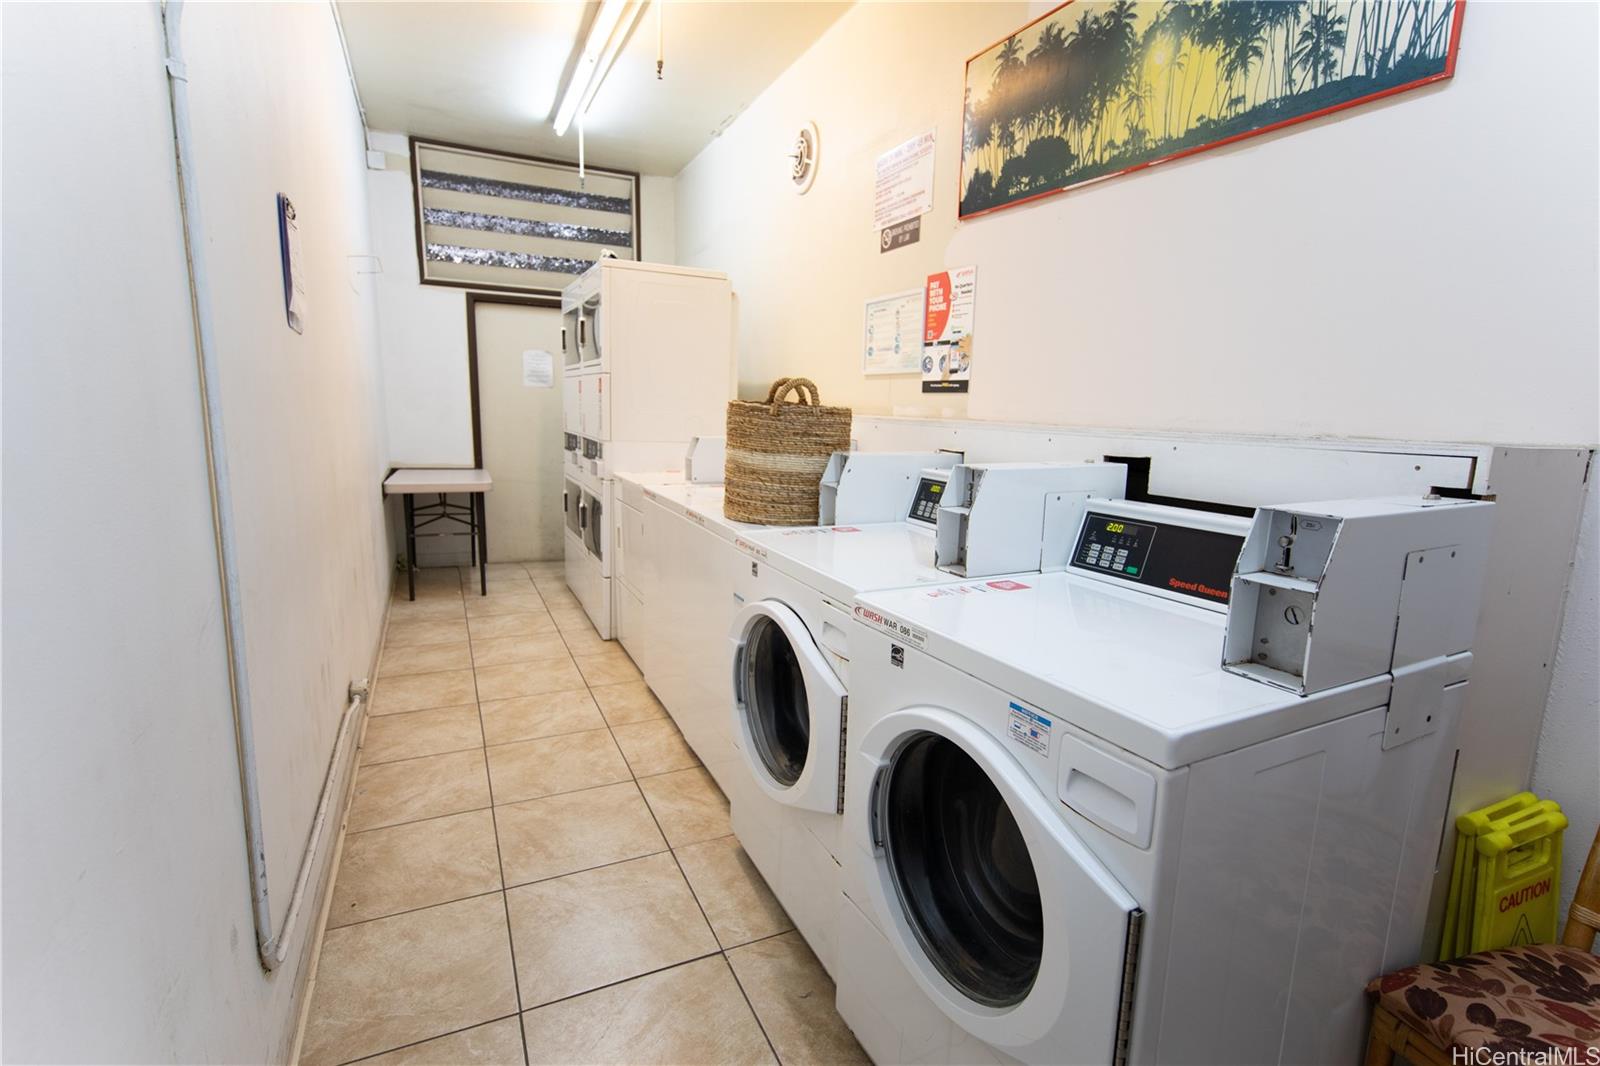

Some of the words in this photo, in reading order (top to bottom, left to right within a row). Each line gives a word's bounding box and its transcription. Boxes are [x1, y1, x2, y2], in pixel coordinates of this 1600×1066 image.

[930, 281, 940, 289] PAY
[930, 288, 944, 297] WITH
[929, 296, 944, 305] YOUR
[929, 303, 947, 312] PHONE
[1169, 578, 1198, 591] Speed
[1198, 584, 1228, 598] Queen
[863, 608, 884, 624] WASH
[884, 618, 898, 630] WAR
[1499, 878, 1551, 913] CAUTION
